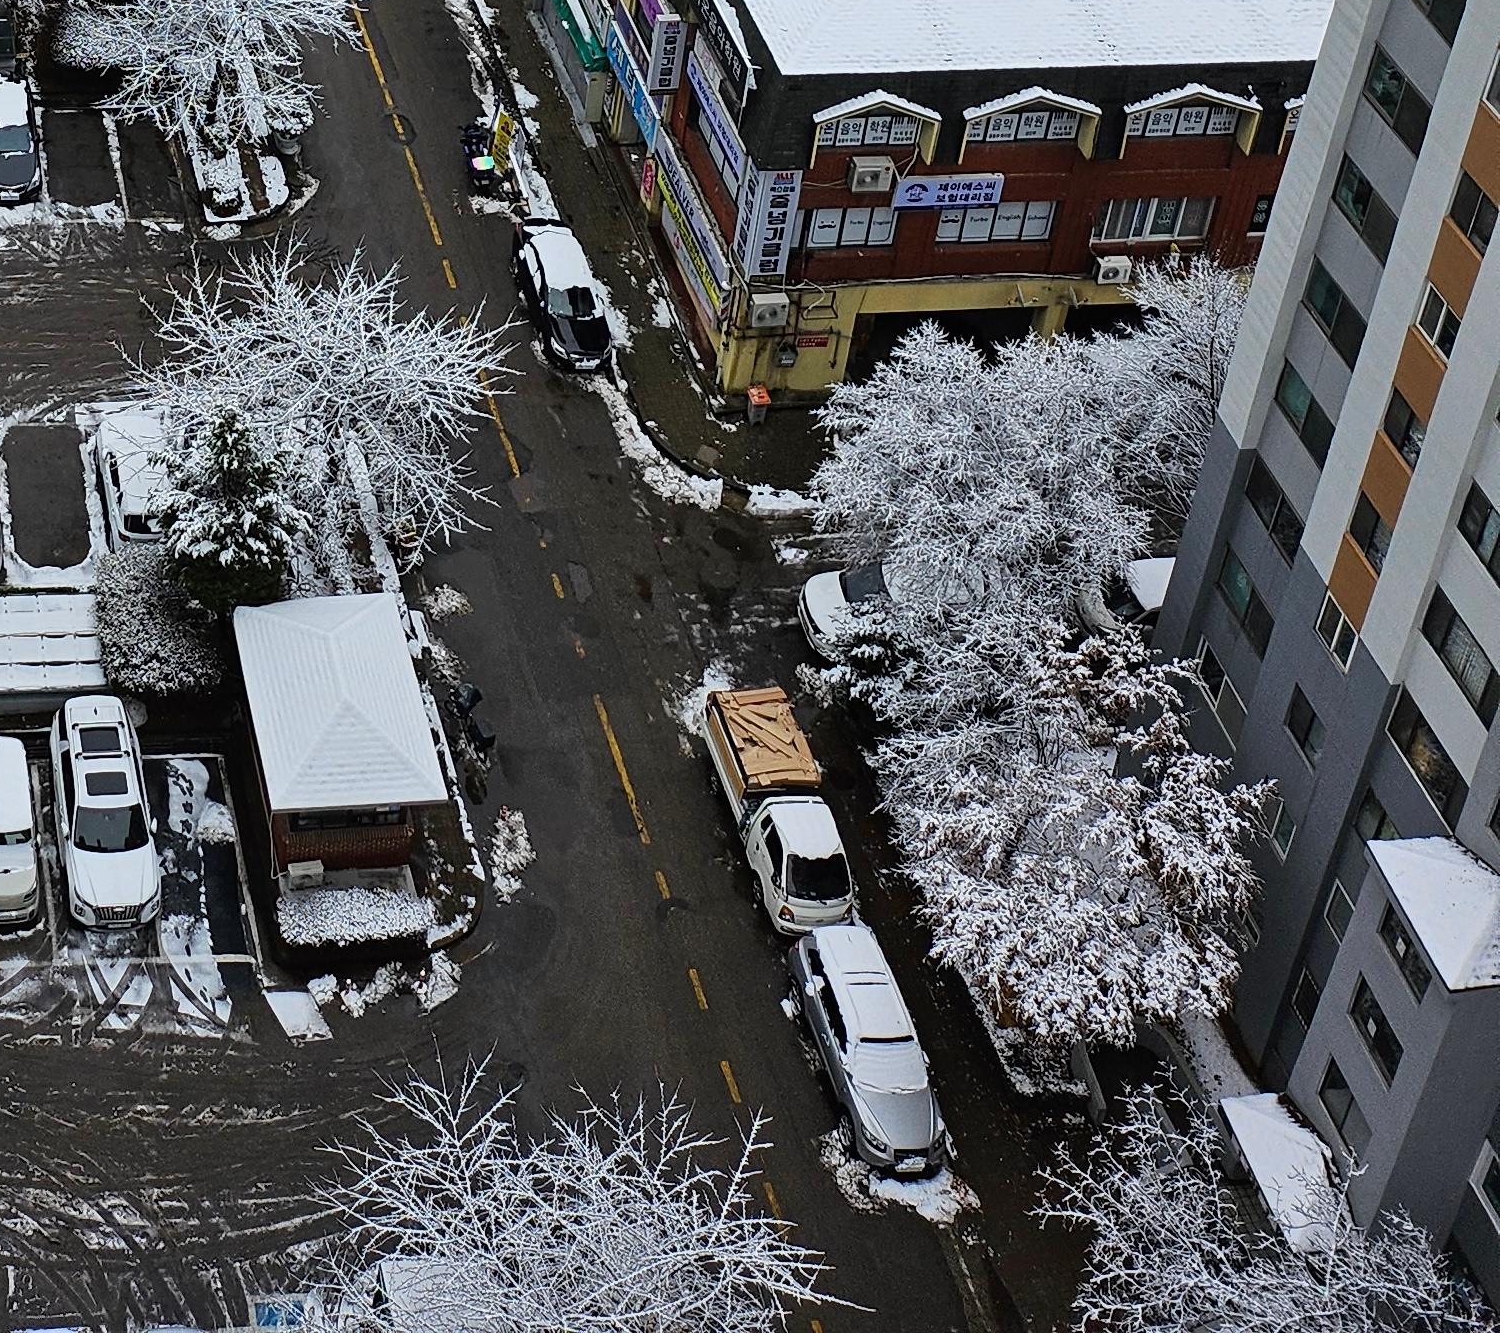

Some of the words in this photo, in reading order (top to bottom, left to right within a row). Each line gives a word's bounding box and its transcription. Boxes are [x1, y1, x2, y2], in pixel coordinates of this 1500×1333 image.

[991, 119, 1014, 132] 음악
[1023, 115, 1044, 128] 학원
[1151, 113, 1174, 126] 음악
[1183, 110, 1205, 123] 학원
[841, 122, 862, 135] 음악
[869, 120, 890, 133] 학원
[937, 180, 997, 192] 제이에스씨
[935, 192, 995, 203] 보험대리점
[997, 214, 1021, 222] English
[758, 194, 790, 273] 줄넘기클럽
